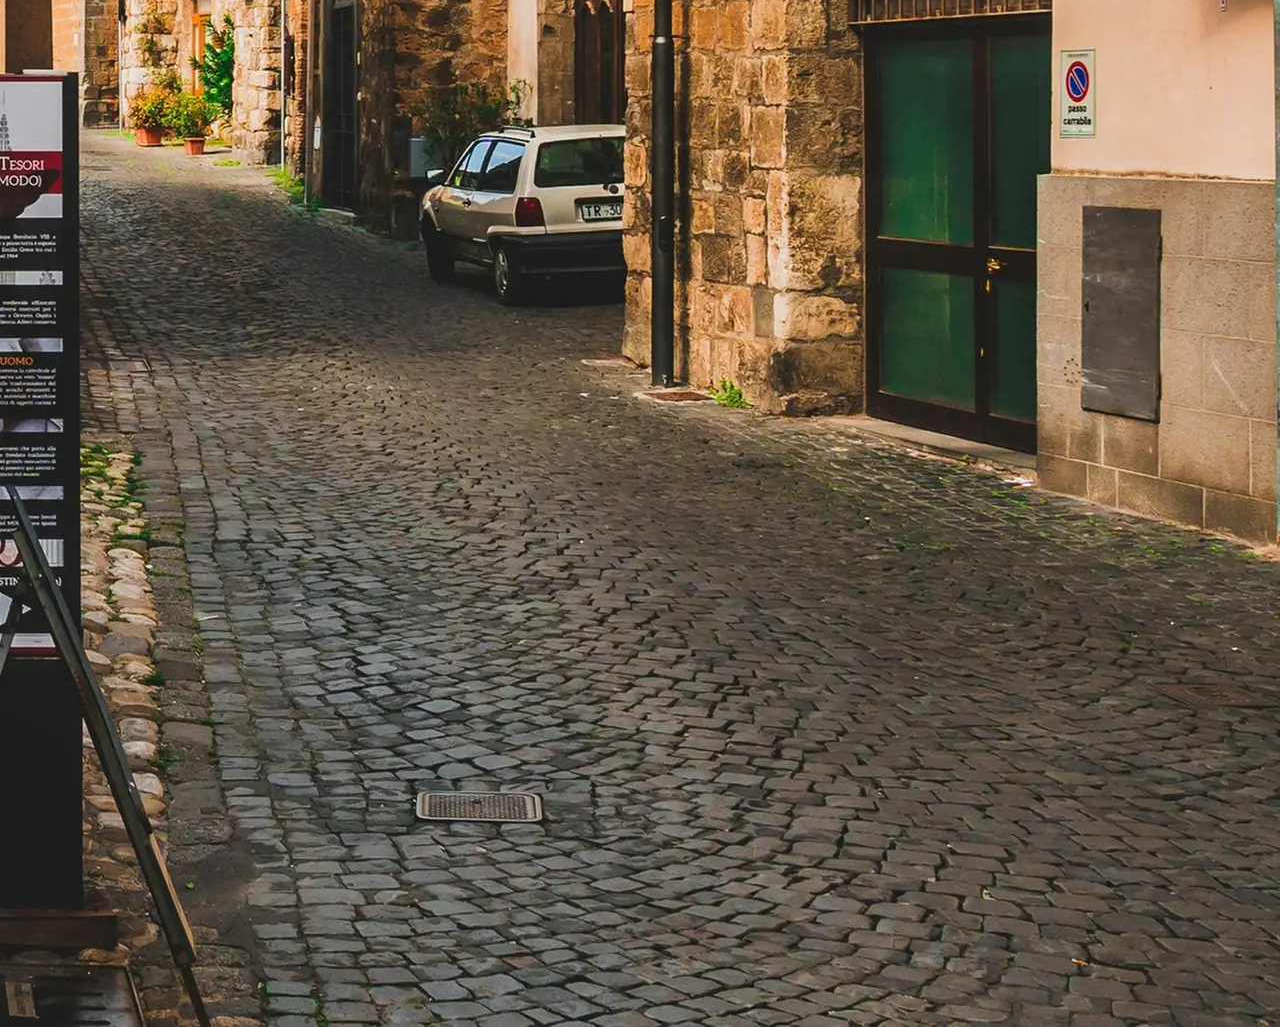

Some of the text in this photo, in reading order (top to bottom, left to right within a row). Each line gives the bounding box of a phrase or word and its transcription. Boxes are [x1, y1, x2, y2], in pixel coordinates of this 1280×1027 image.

[1068, 106, 1087, 114] passo
[1063, 117, 1092, 125] carrabile
[585, 206, 601, 217] TR
